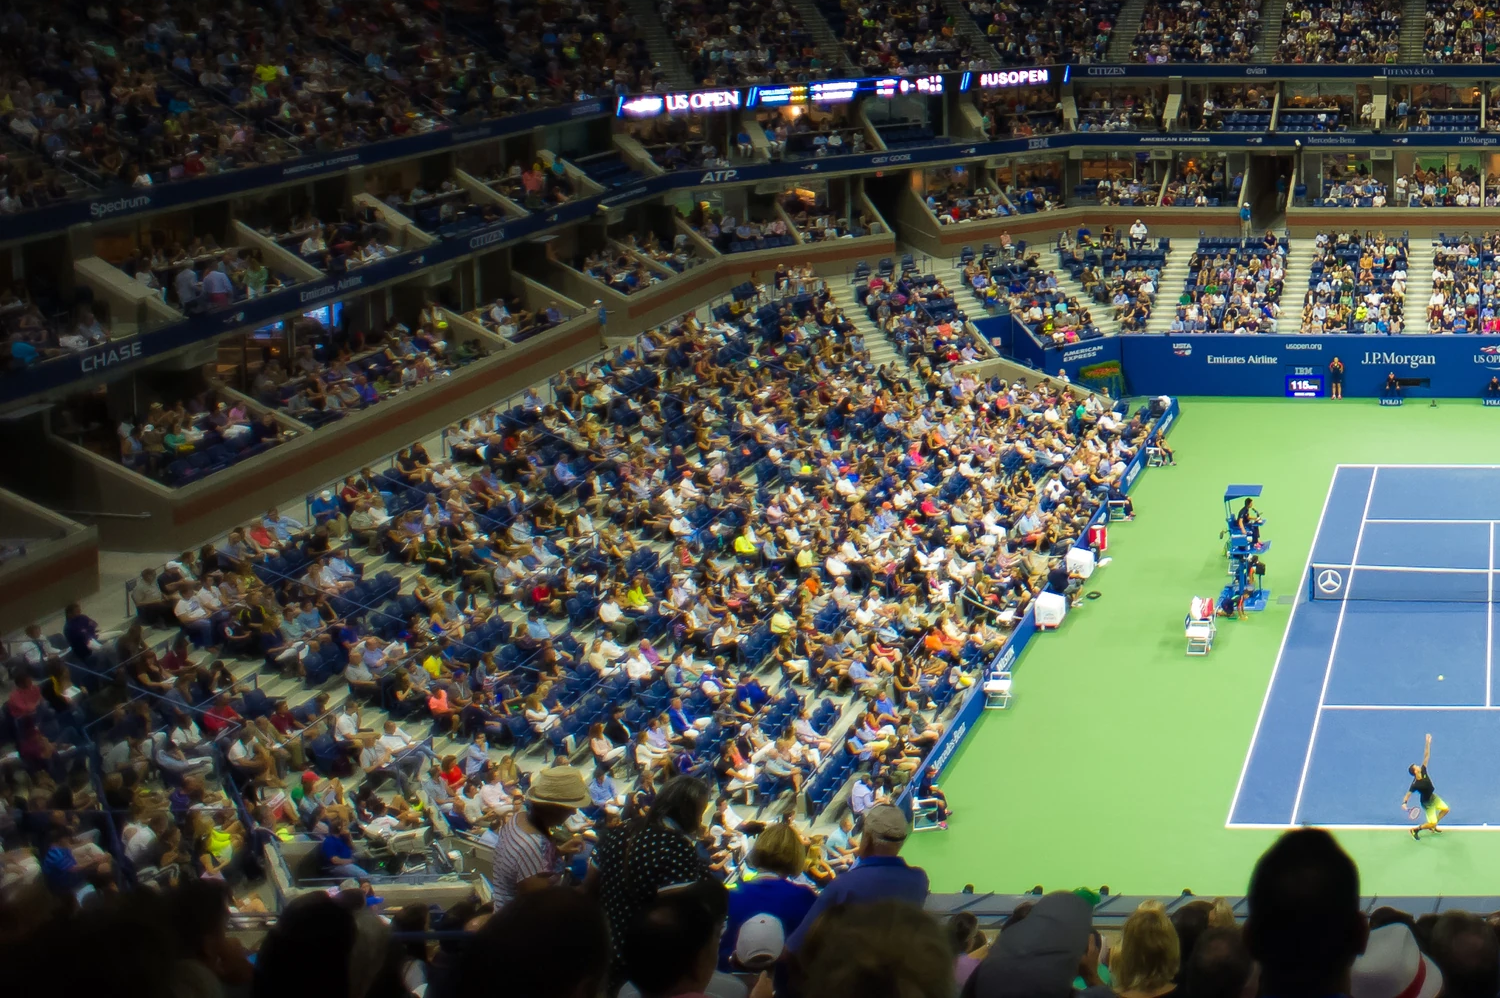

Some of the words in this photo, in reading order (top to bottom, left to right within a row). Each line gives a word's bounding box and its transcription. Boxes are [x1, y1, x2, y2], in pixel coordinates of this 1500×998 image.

[1088, 67, 1126, 75] CITIZEN
[1246, 67, 1267, 75] evian
[980, 69, 1049, 86] #USOPEN
[664, 93, 690, 110] US
[690, 90, 740, 108] OPEN
[1028, 138, 1050, 149] IBM
[1307, 136, 1356, 144] Mercedes-Benz
[701, 170, 736, 184] ATP
[90, 195, 147, 218] Spectrum
[469, 228, 505, 249] CITIZEN
[300, 284, 336, 303] Emirates
[1063, 345, 1104, 357] AMERICAN
[1285, 343, 1322, 351] usopen.org
[80, 342, 143, 373] CHASE
[1063, 351, 1097, 363] EXPRESS
[1206, 355, 1246, 364] Emirates
[1248, 355, 1278, 364] Airline
[1361, 351, 1436, 369] J.P.Morgan
[1473, 354, 1485, 364] US
[1294, 367, 1313, 375] IBM
